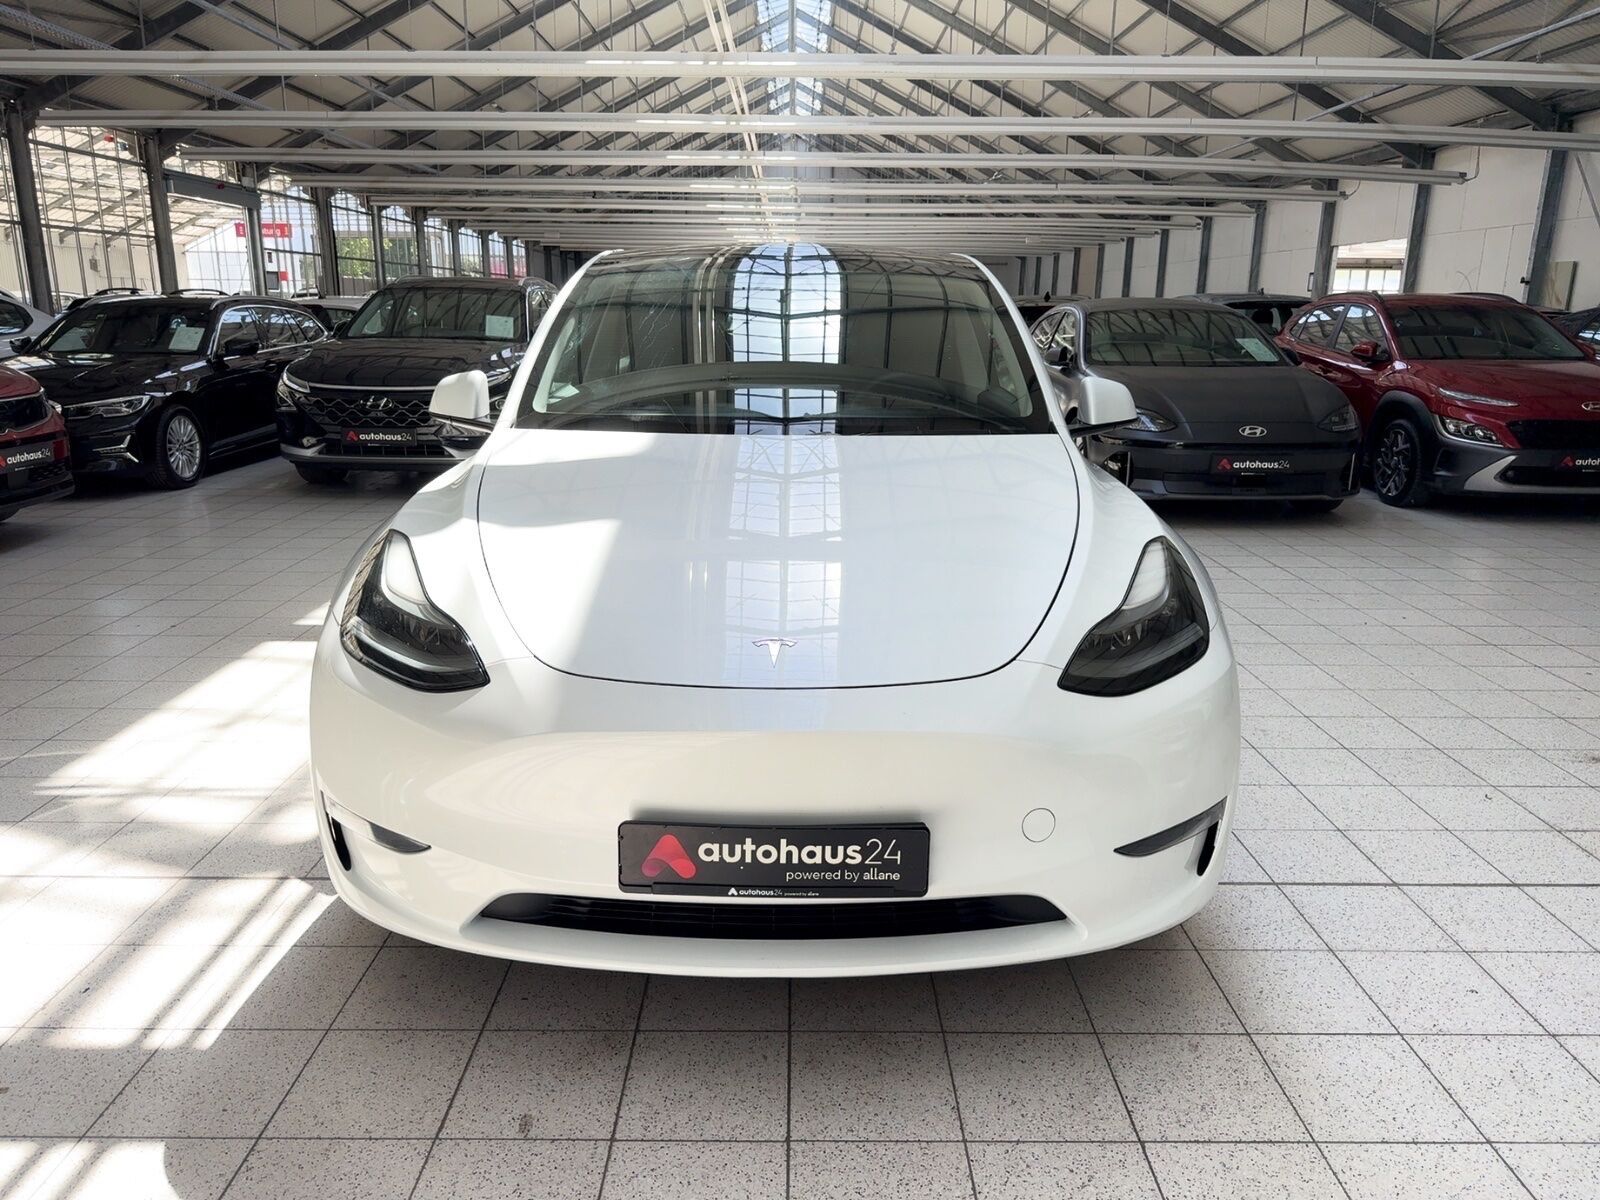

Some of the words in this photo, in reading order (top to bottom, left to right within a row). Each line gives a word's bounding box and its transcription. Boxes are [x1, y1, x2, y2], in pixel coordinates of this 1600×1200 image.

[360, 432, 412, 441] autohaus24
[6, 448, 51, 464] autohaus24
[1232, 460, 1290, 469] autohaus24
[697, 837, 902, 865] autohaus24
[786, 870, 841, 882] powered
[844, 870, 860, 883] by
[863, 870, 901, 881] allane
[739, 888, 783, 896] autohaus24
